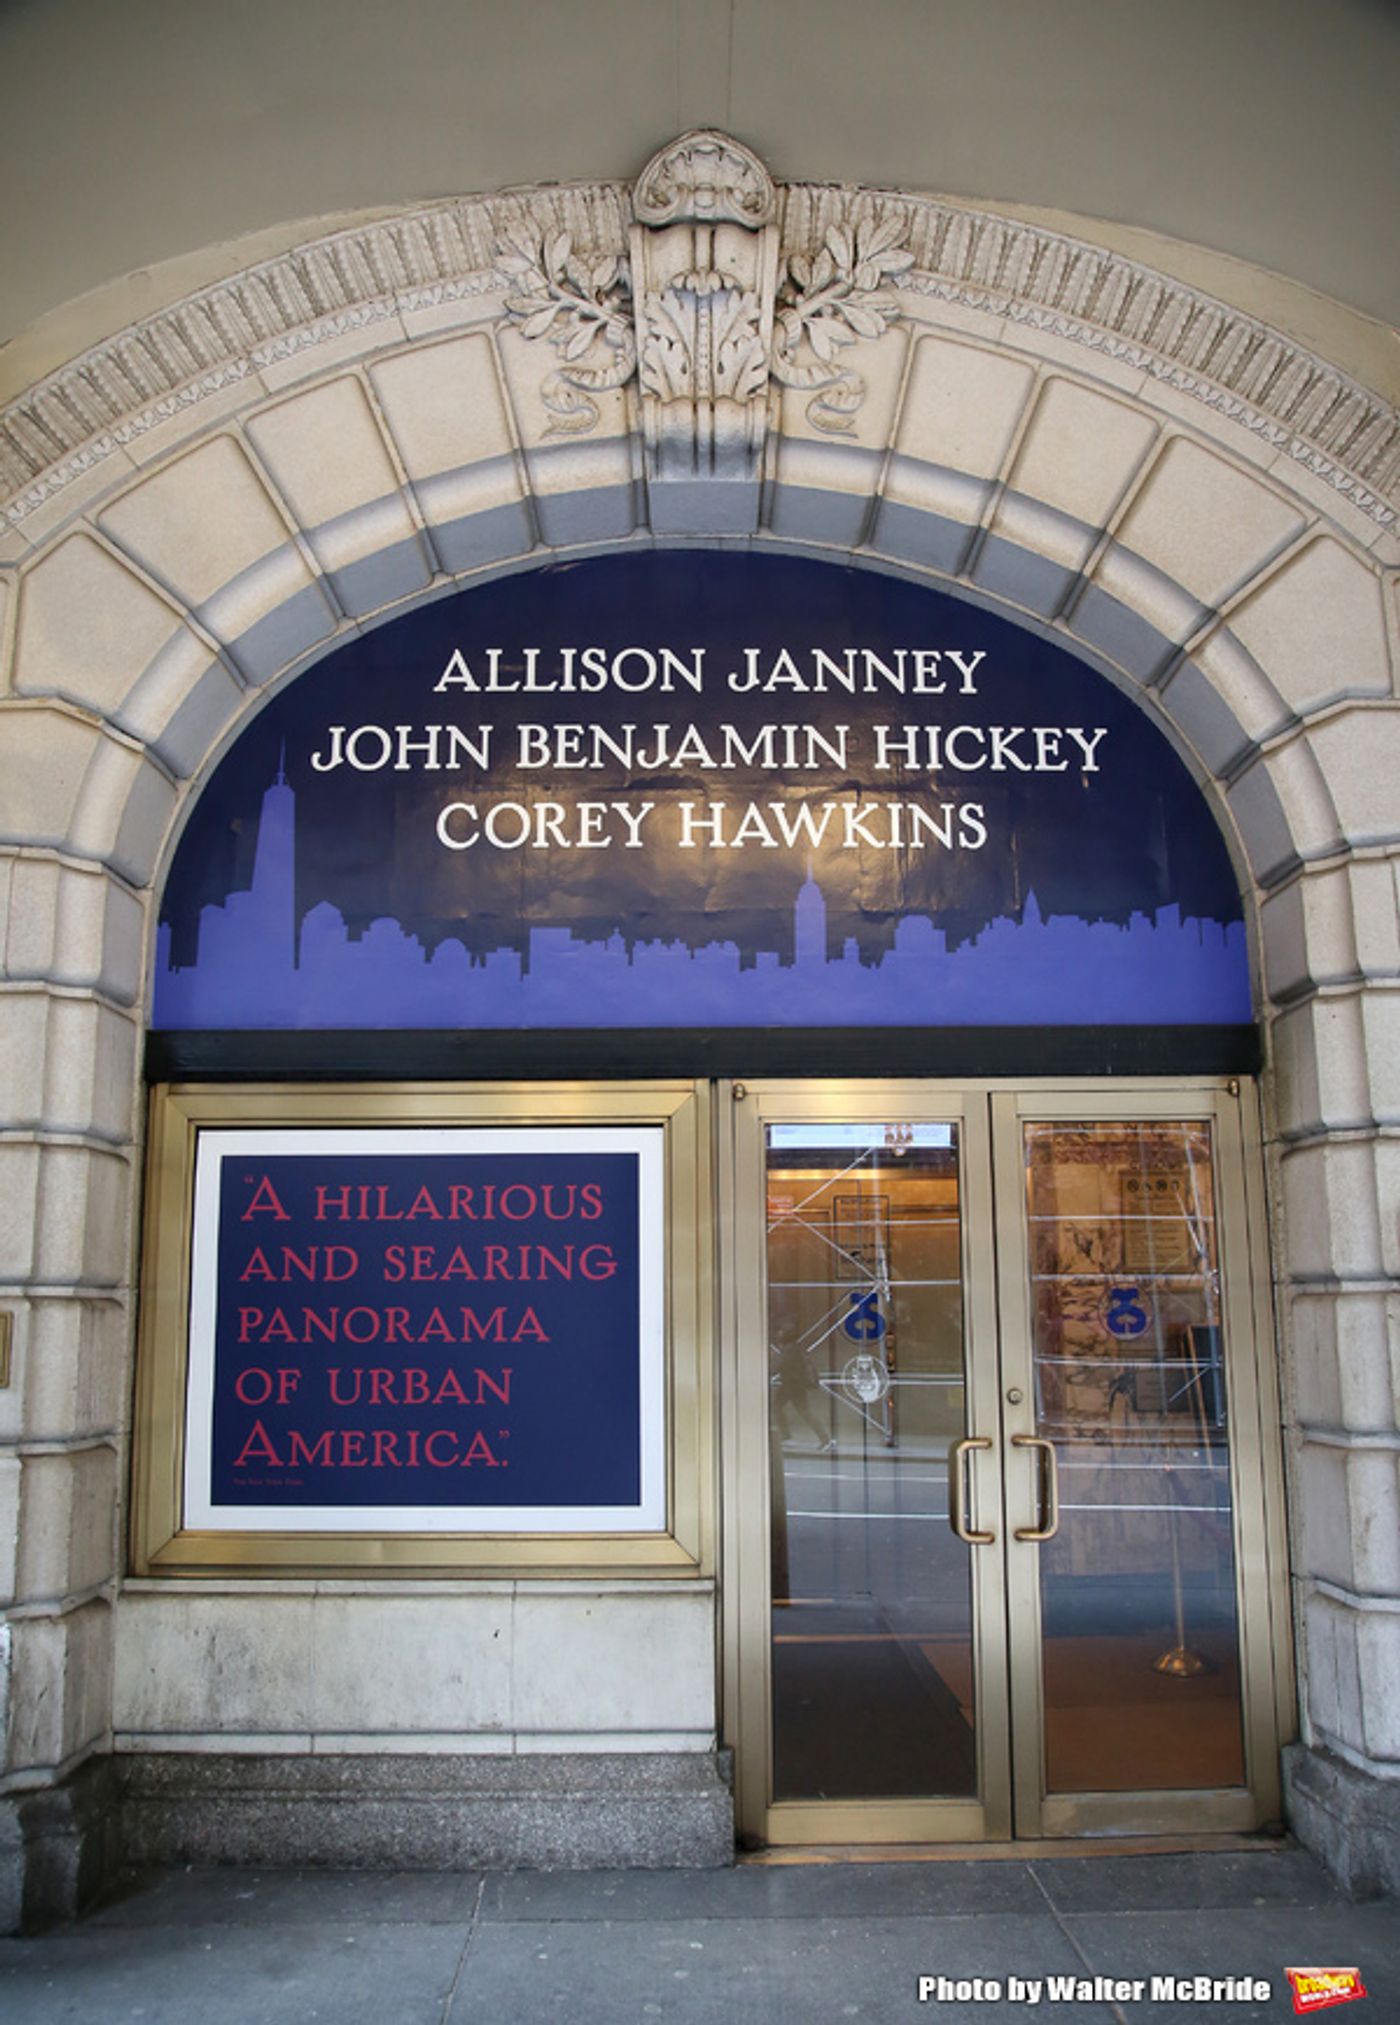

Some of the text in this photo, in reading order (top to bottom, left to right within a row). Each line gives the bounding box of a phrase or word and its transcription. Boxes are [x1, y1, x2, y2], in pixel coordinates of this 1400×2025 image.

[433, 648, 986, 694] ALLISON JANNEY
[311, 724, 1107, 772] JOHN BENJAMIN HICKEY
[436, 801, 987, 849] COREY HAWKINS
[314, 1183, 603, 1221] HILARIOUS
[239, 1244, 617, 1282] AND SEARING
[237, 1305, 550, 1344] PANORAMA
[235, 1367, 512, 1406] OF URBAN
